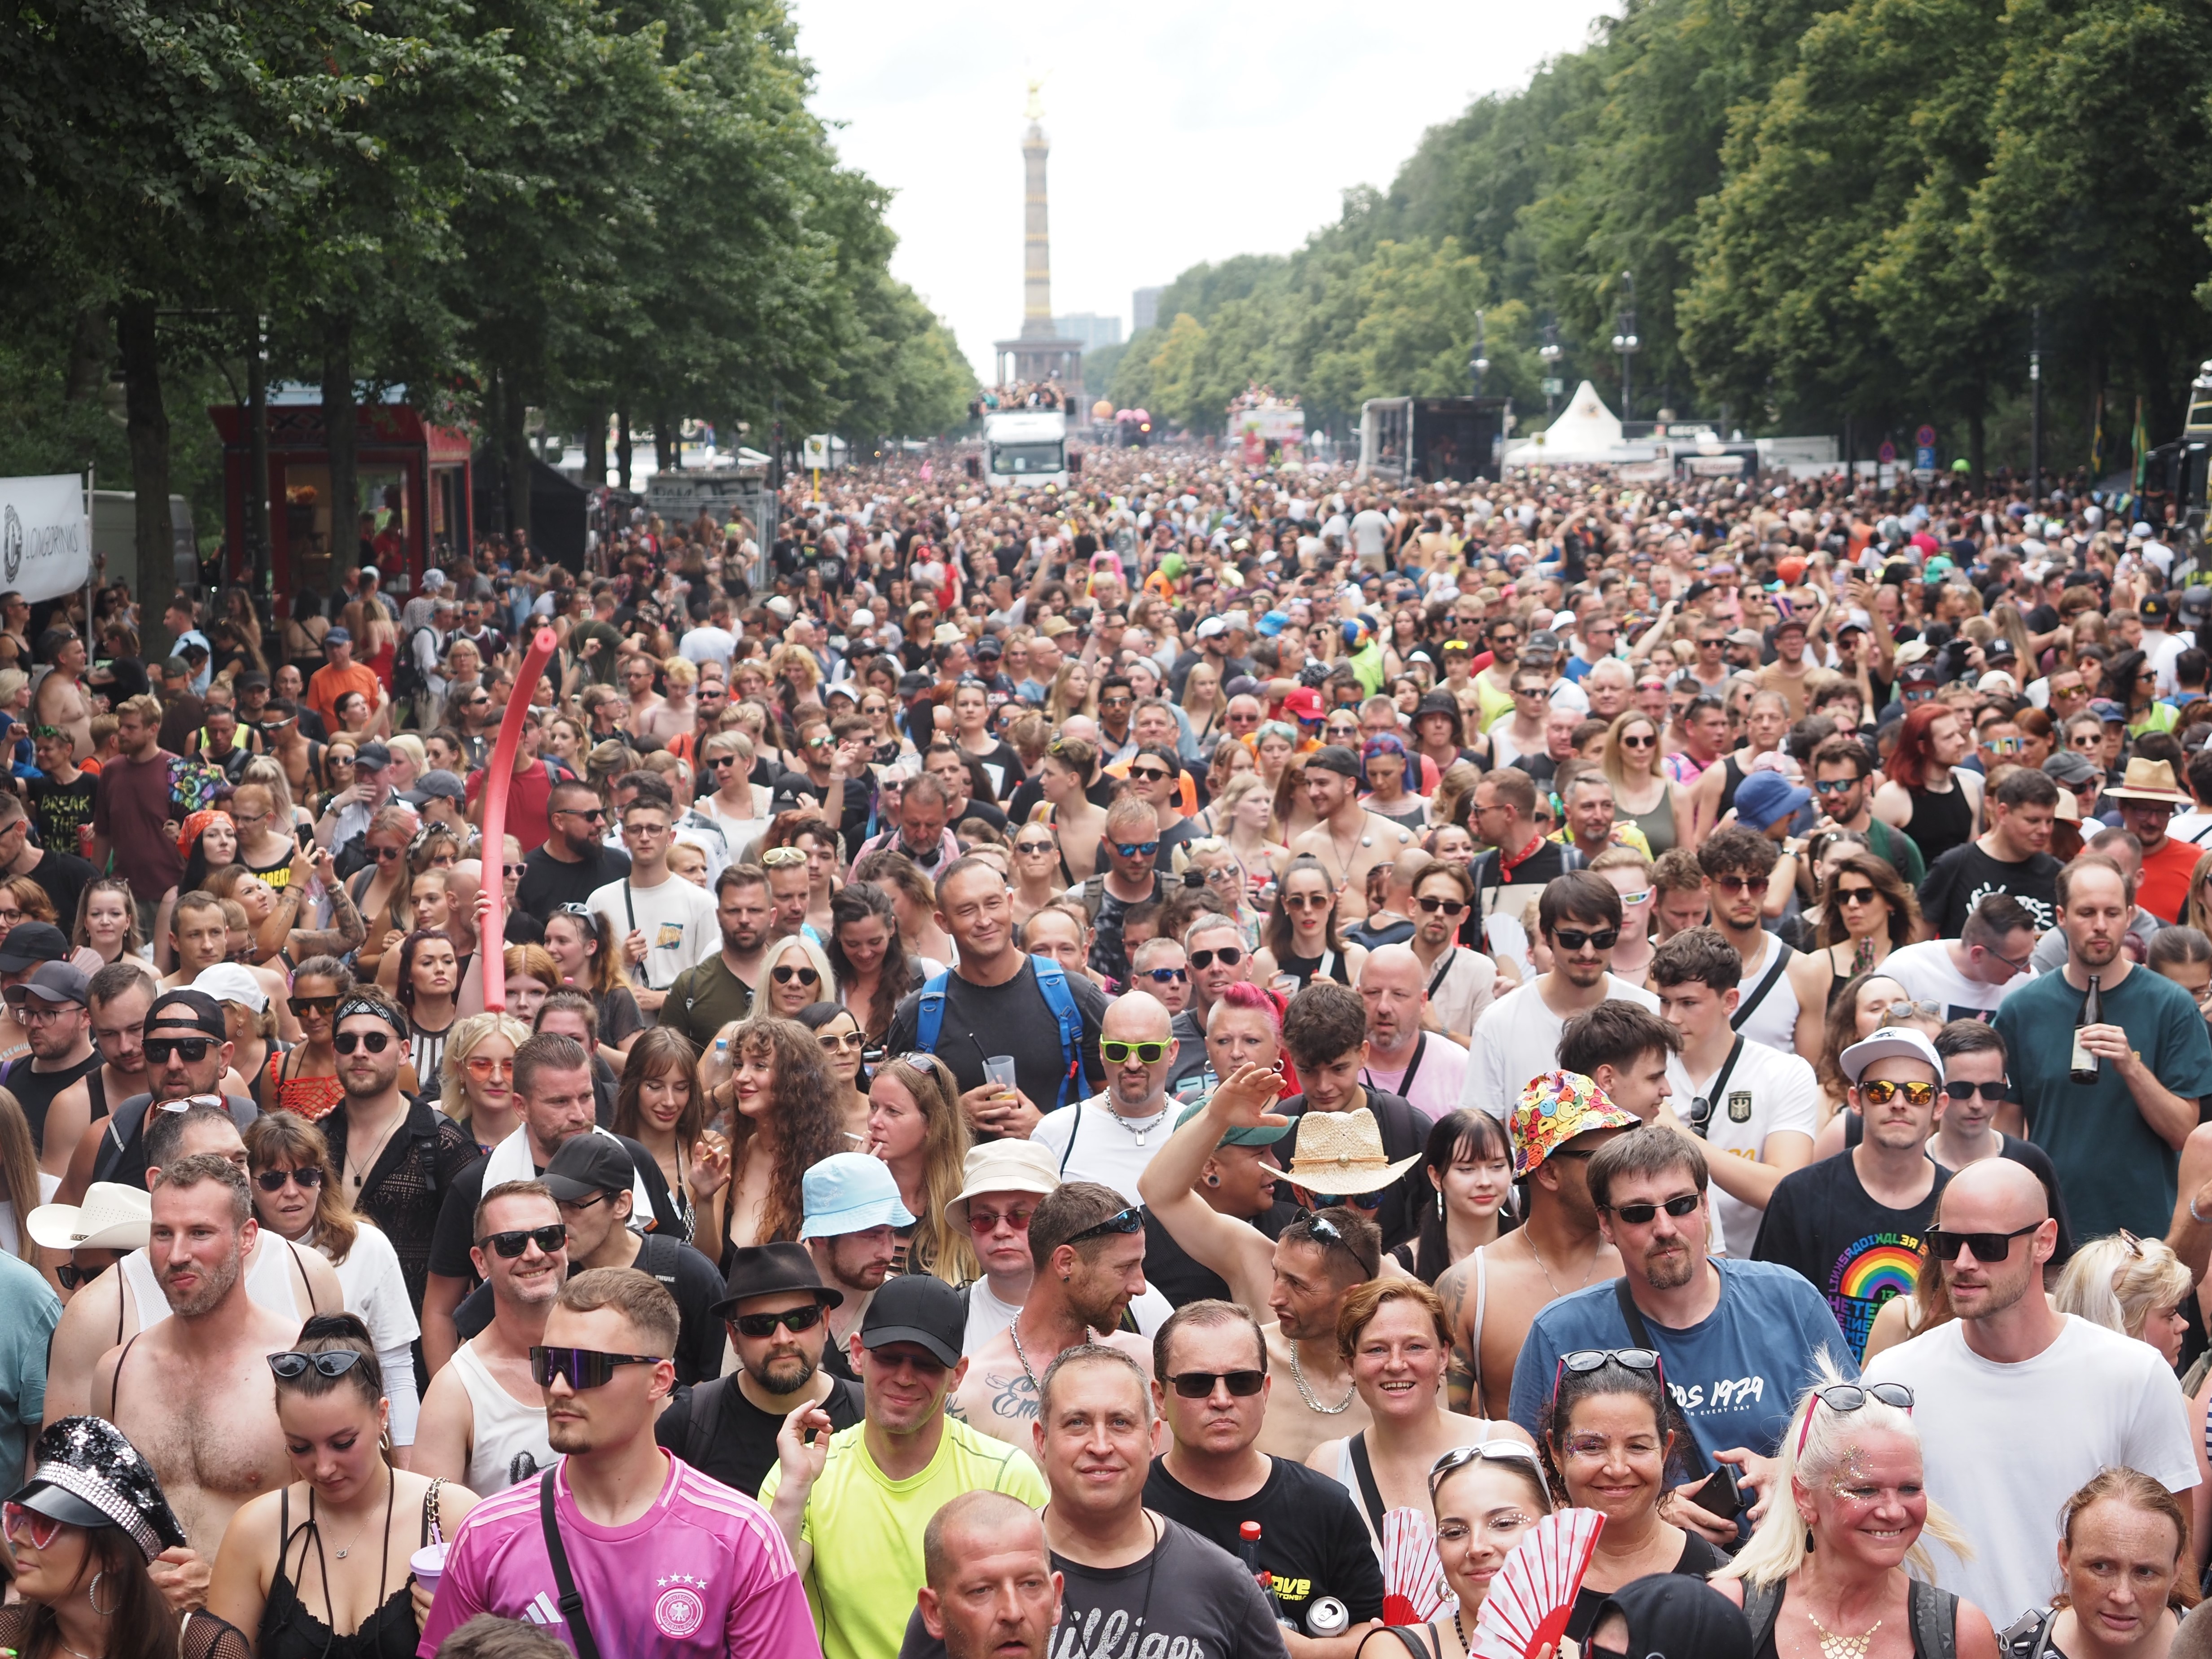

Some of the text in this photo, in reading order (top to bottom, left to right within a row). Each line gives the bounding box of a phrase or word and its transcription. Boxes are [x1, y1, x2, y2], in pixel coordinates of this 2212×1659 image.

[26, 523, 78, 559] LONGDRINKS
[40, 794, 89, 814] BREAK
[50, 815, 79, 834] THE
[0, 1042, 31, 1061] REMIU
[1828, 1295, 1883, 1319] HETE
[1710, 1376, 1764, 1407] 1979
[1700, 1408, 1728, 1416] EVERY
[1271, 1576, 1310, 1595] ove
[667, 1595, 694, 1606] DEUTSCHER
